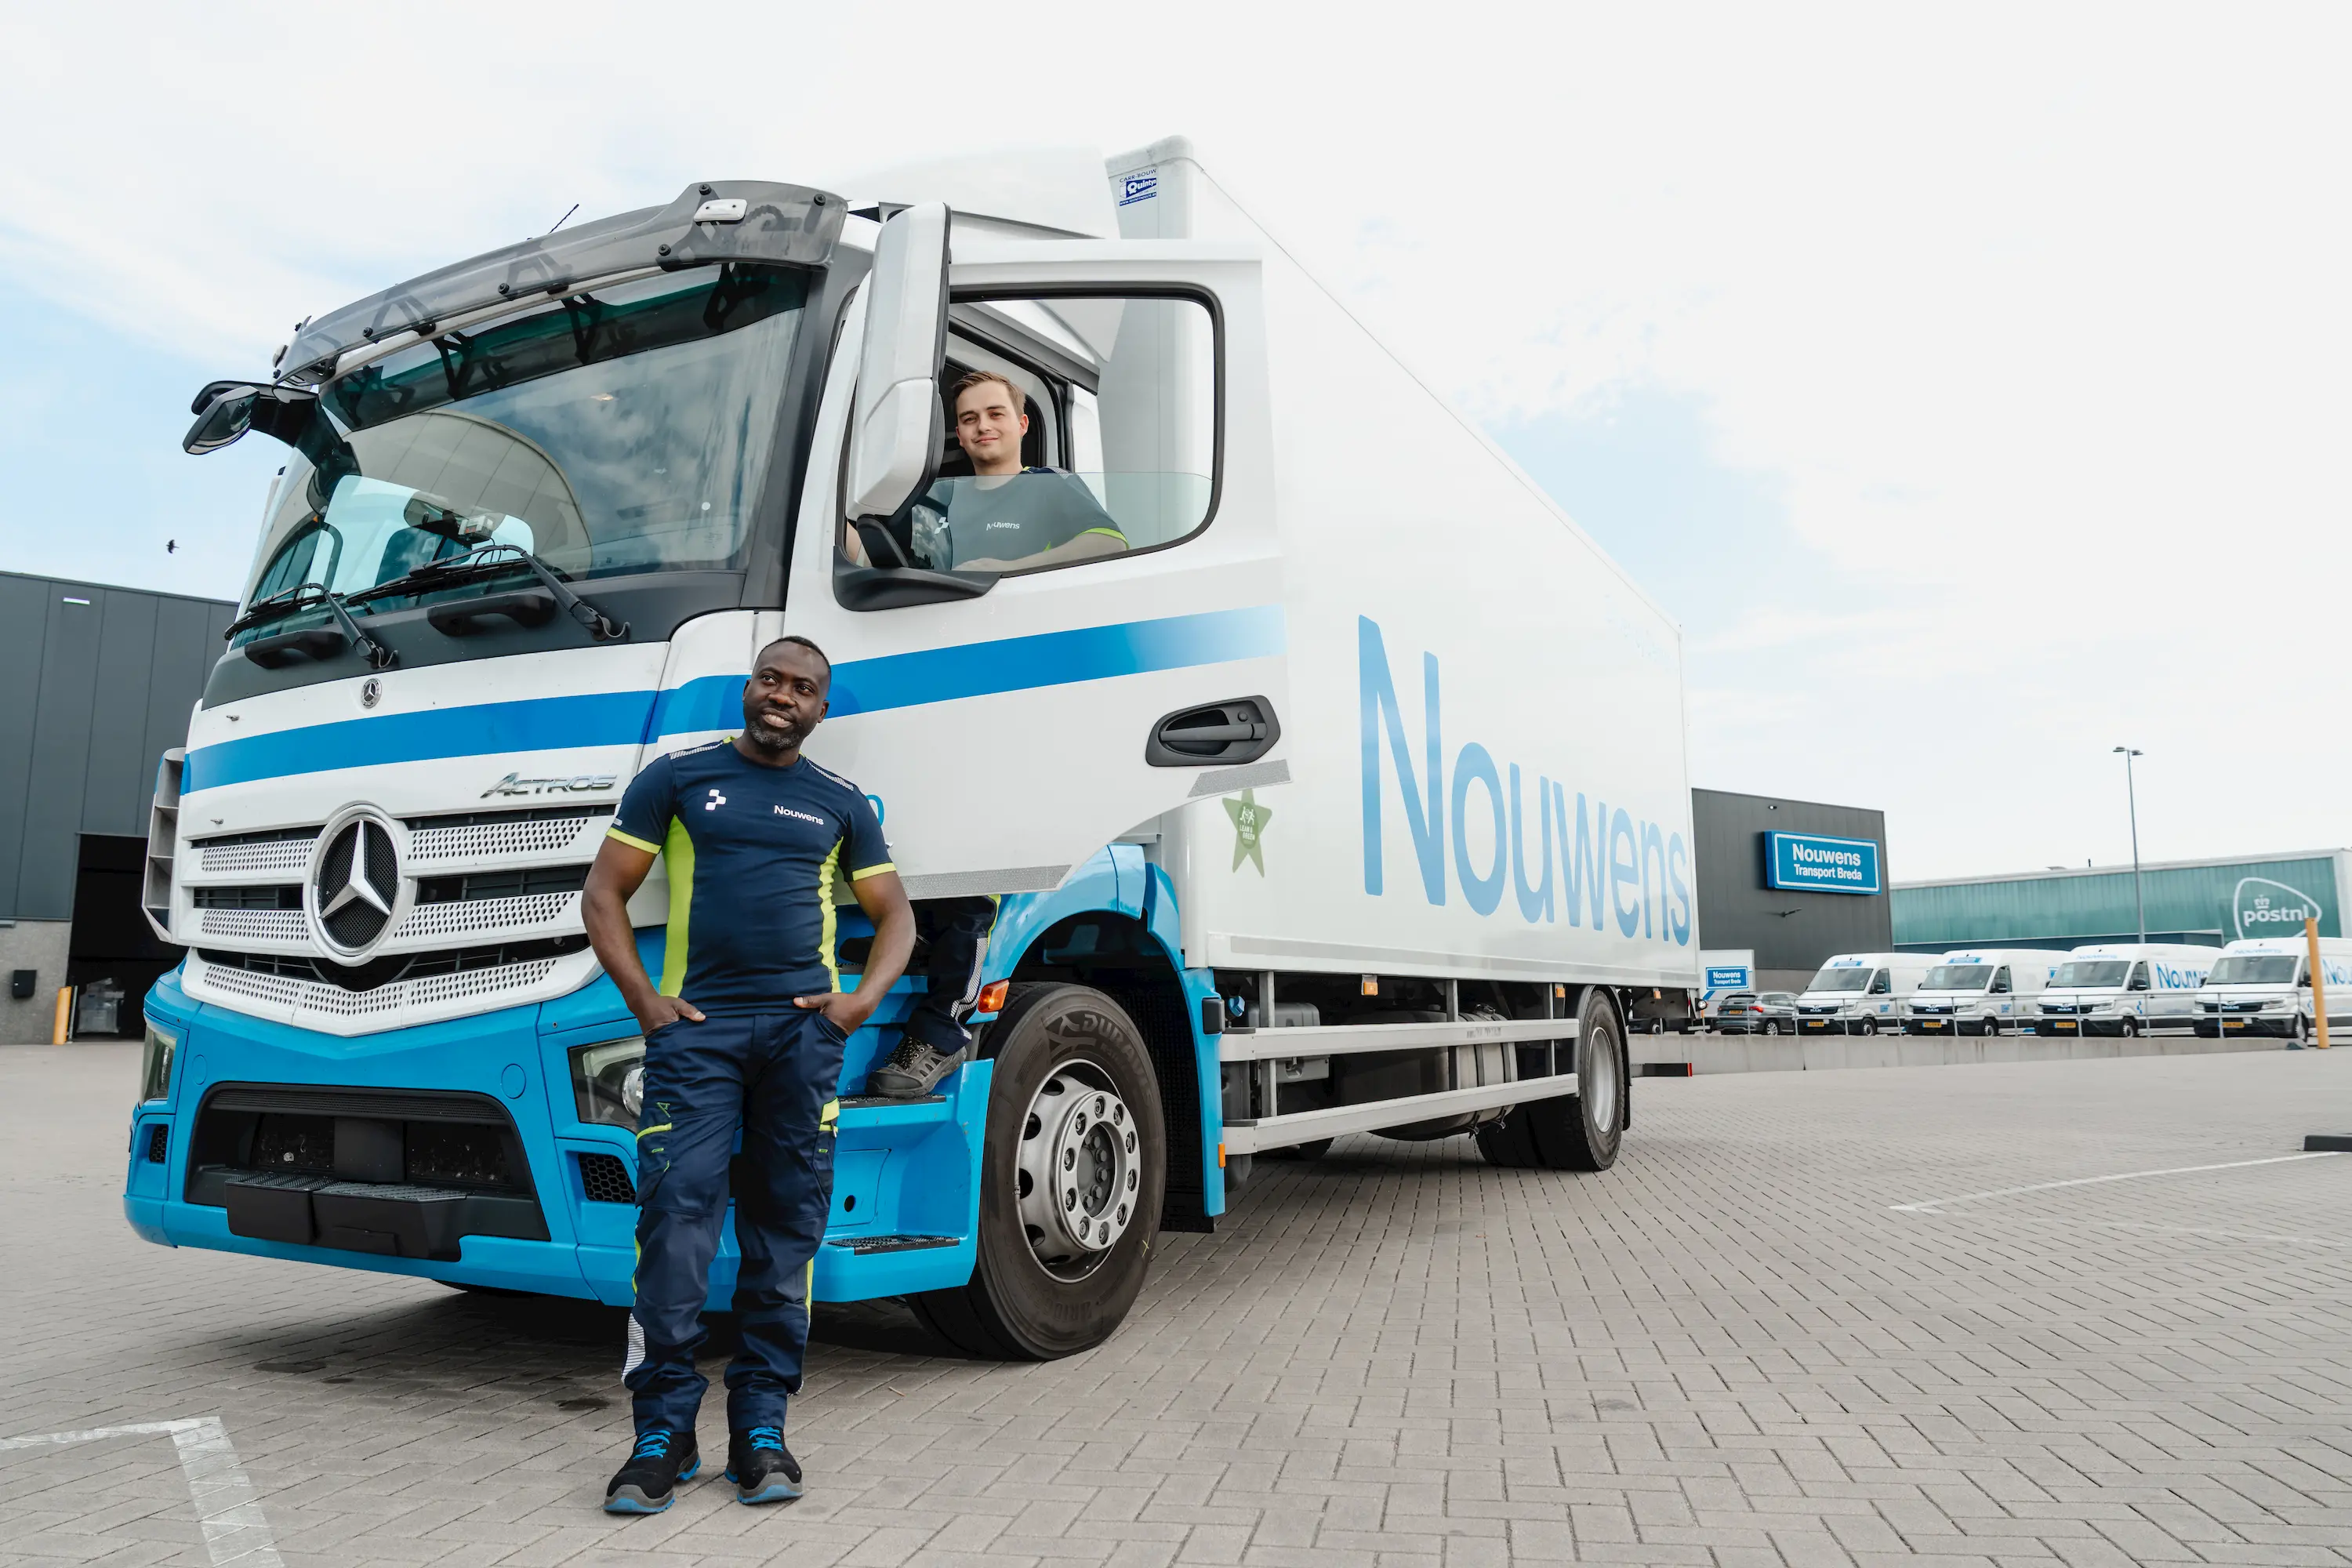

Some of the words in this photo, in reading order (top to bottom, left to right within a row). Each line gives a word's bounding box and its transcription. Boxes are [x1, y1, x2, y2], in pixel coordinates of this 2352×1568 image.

[986, 521, 1021, 531] Nuwens
[1359, 615, 1690, 946] Nouwens
[774, 804, 824, 825] Nouwens
[1792, 844, 1861, 866] Nouwens
[1794, 864, 1836, 879] Transport
[1837, 867, 1862, 880] Breda
